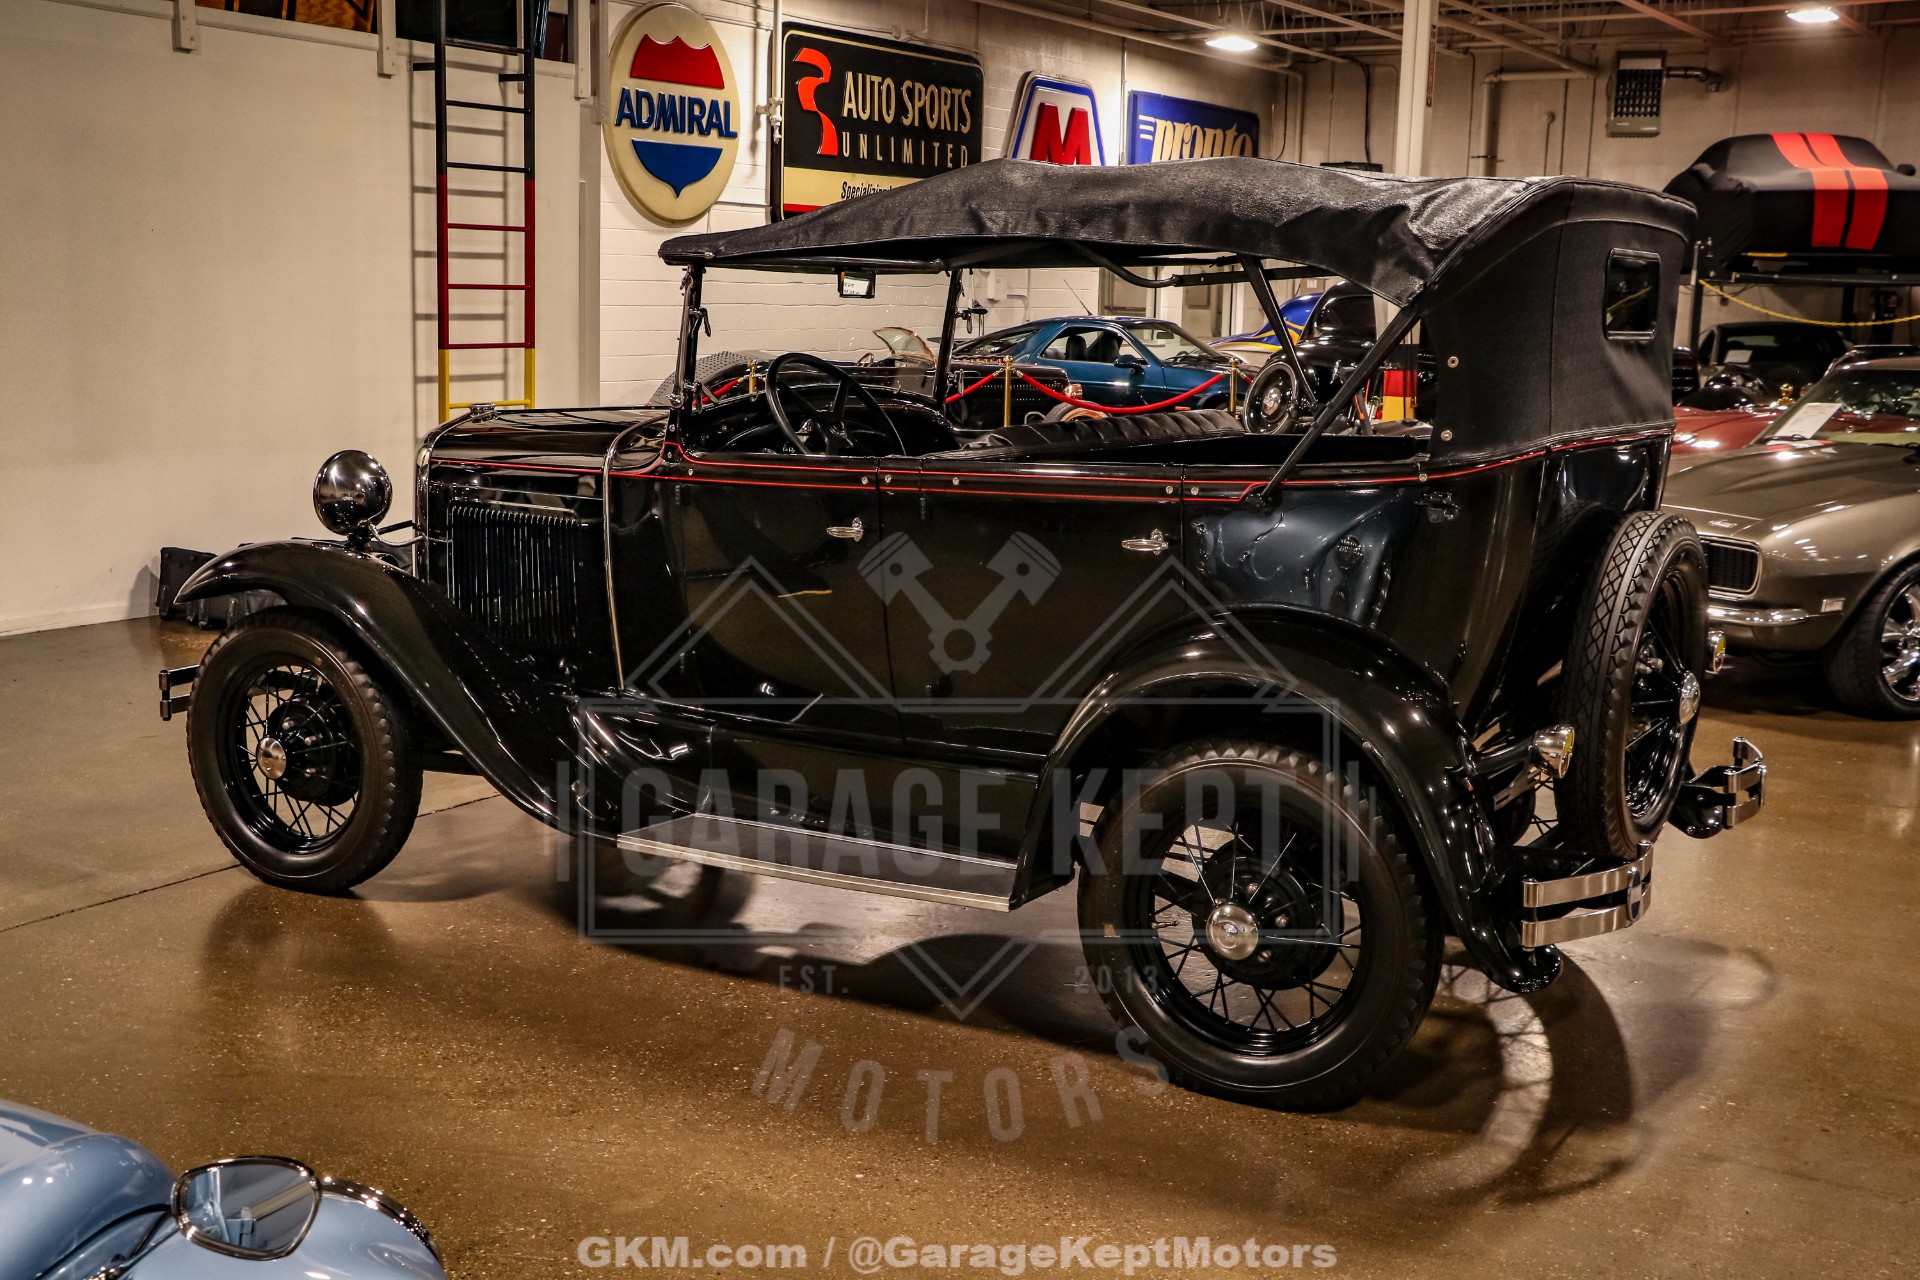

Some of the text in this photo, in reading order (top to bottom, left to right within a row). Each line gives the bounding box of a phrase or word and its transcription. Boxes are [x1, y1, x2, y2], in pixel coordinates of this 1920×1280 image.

[614, 86, 738, 138] ADMIRAL
[842, 71, 971, 134] AUTO SPORTS
[842, 131, 968, 168] UNLIMITED
[1030, 102, 1092, 165] M
[1151, 119, 1253, 162] pronto
